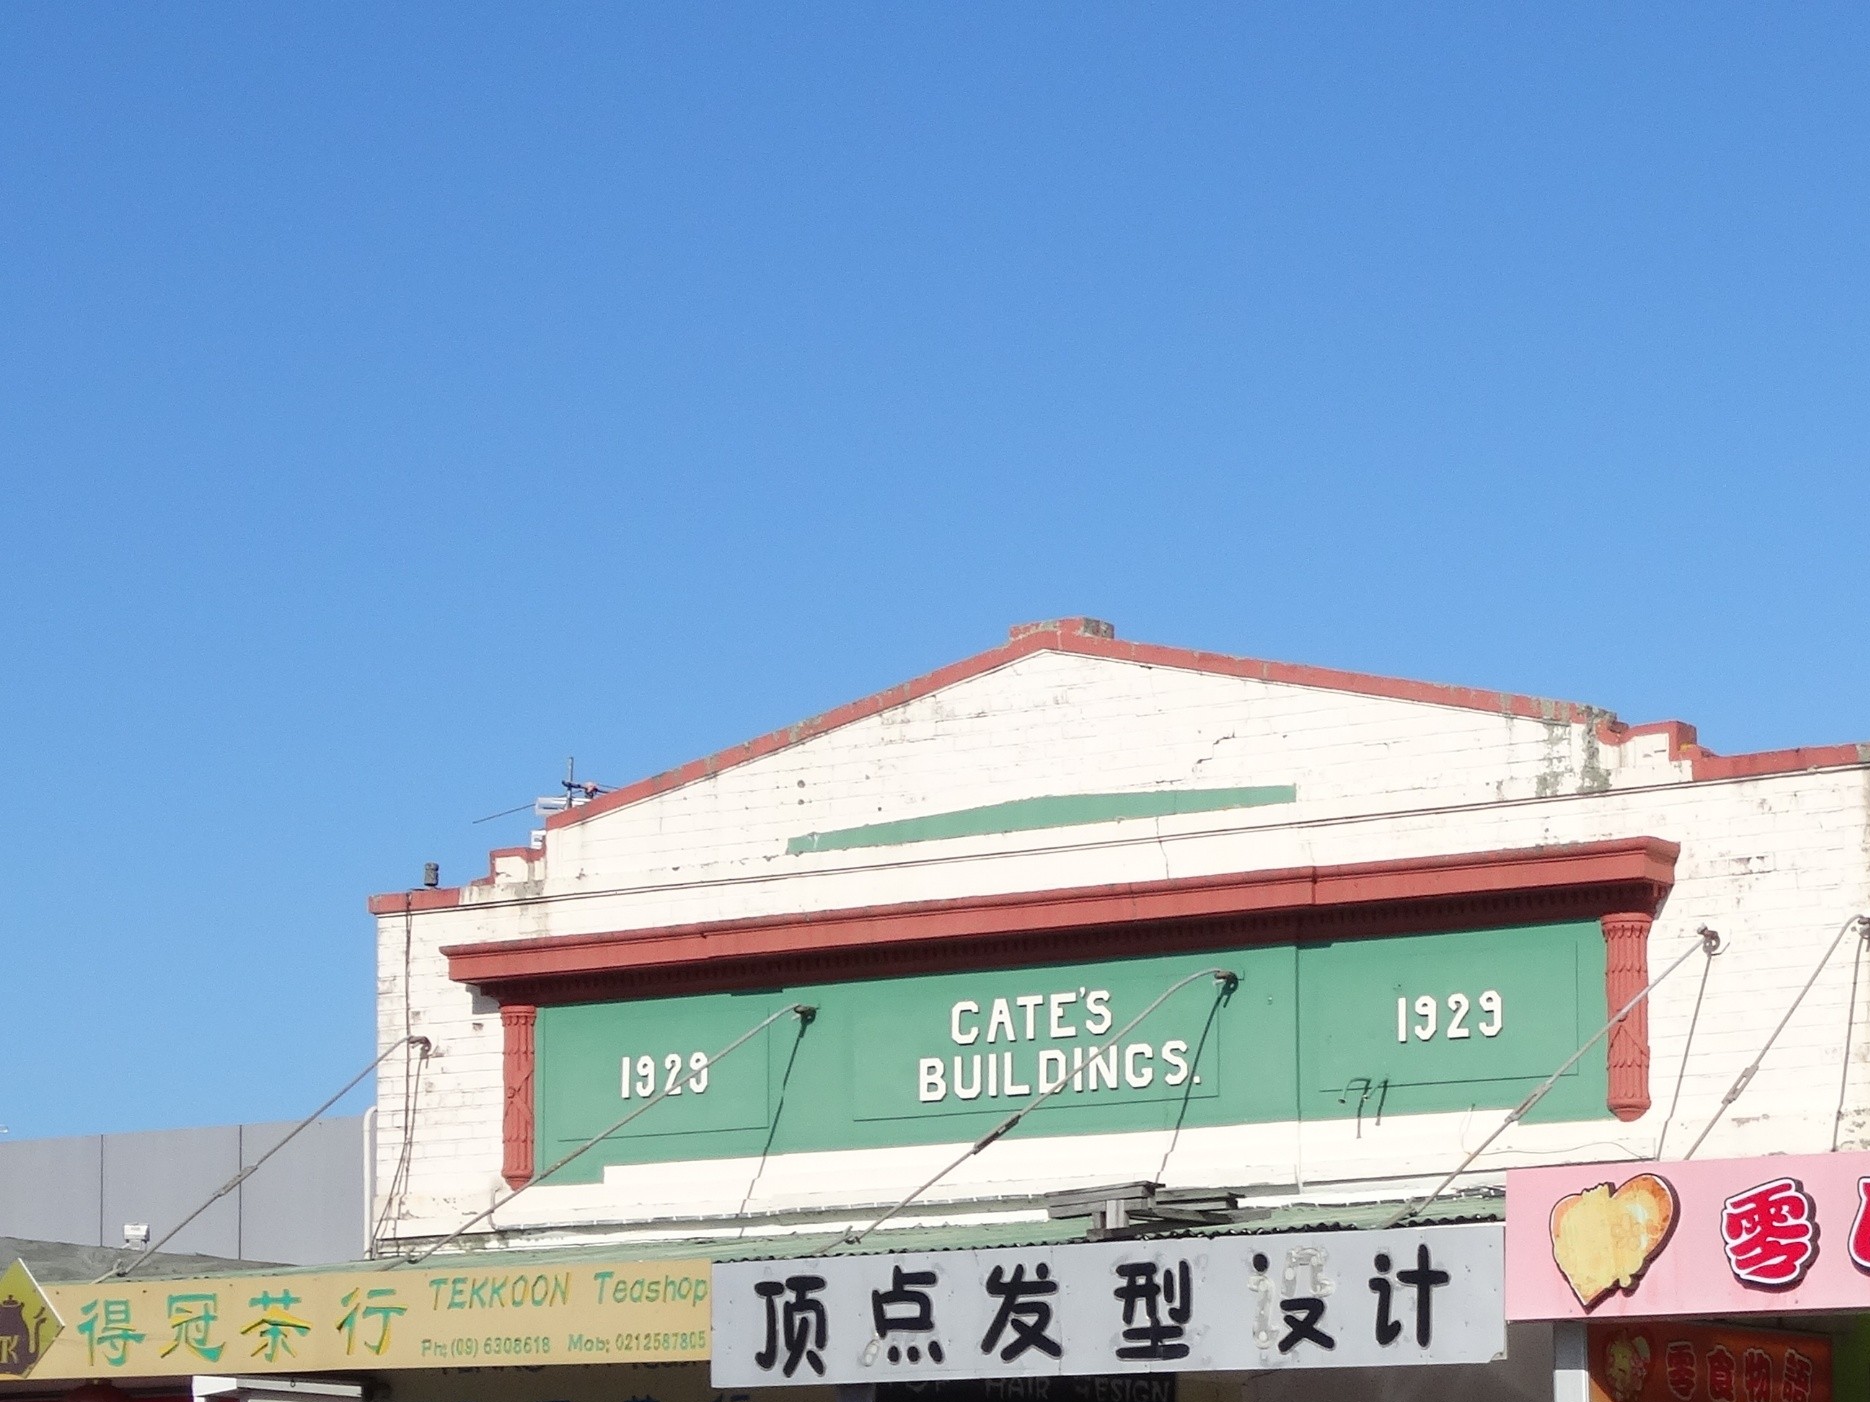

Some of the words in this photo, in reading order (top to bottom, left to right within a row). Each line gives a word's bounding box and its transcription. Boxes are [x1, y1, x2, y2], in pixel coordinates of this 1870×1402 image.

[950, 986, 1113, 1045] CATE'S
[1397, 990, 1504, 1043] 1929
[620, 1052, 709, 1099] 1929
[918, 1040, 1201, 1103] BUILDINGS.
[429, 1272, 571, 1310] TEKKOON
[594, 1271, 708, 1307] Teashop
[754, 1243, 1451, 1378] 顶点发型设计
[78, 1287, 408, 1366] 得冠茶行
